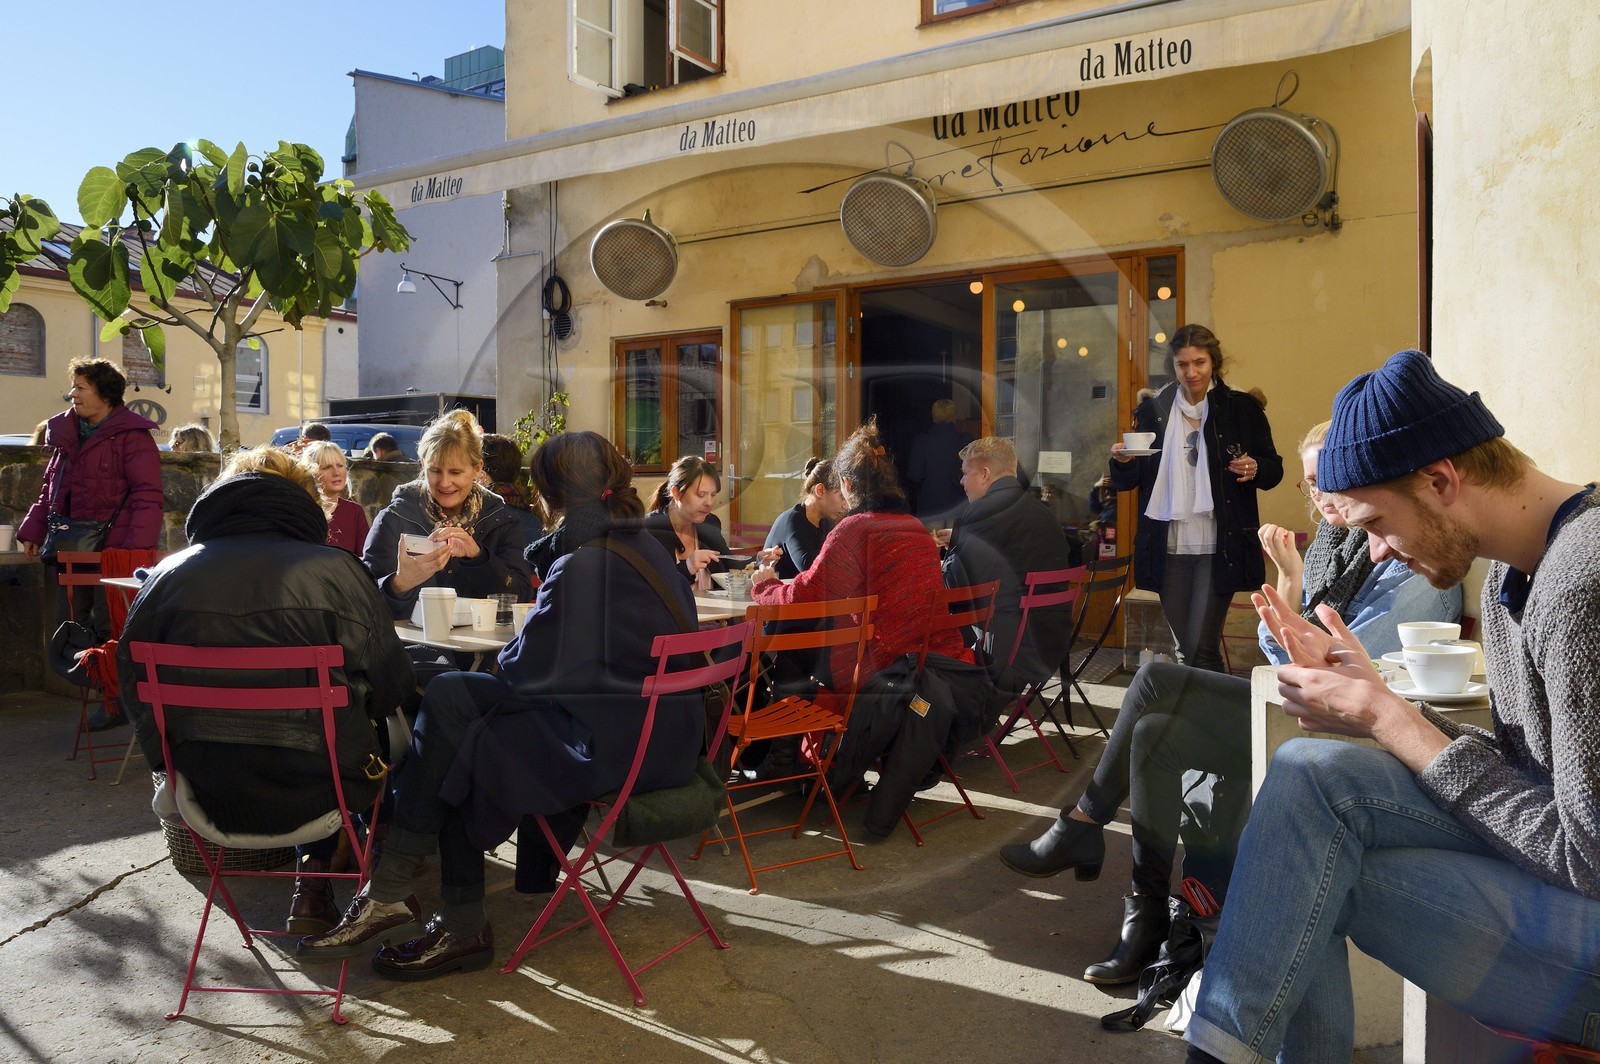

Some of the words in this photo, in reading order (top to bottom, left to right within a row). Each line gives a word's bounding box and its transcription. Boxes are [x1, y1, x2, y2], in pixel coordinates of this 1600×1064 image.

[1080, 48, 1105, 81] da
[1114, 37, 1192, 77] Matteo
[679, 125, 697, 151] da
[701, 118, 756, 148] Matteo
[411, 180, 423, 203] da
[425, 175, 463, 200] Matteo
